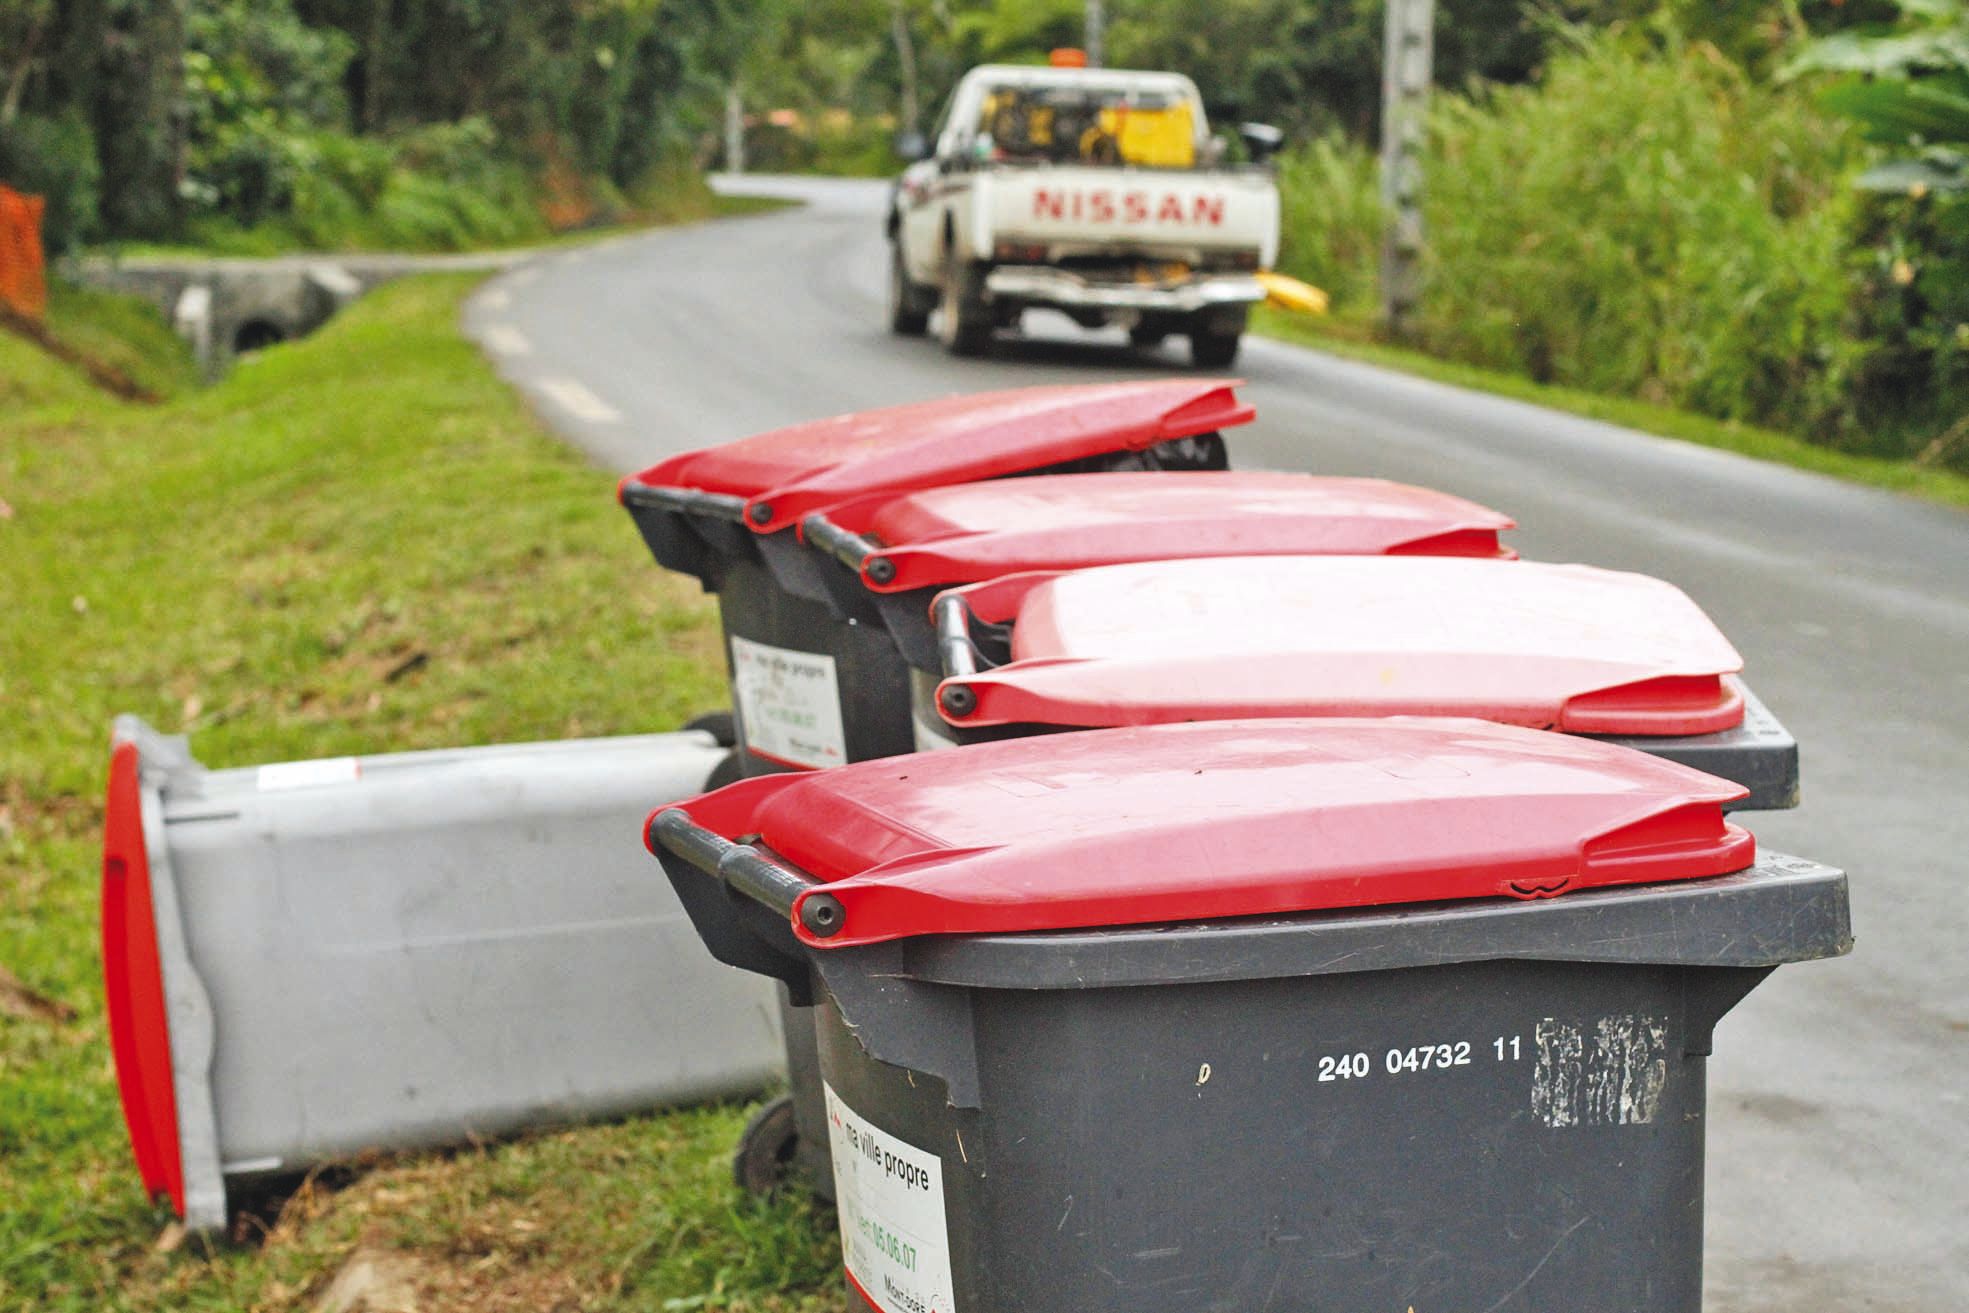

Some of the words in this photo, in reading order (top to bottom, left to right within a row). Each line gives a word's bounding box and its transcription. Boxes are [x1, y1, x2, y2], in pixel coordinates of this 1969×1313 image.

[1033, 189, 1224, 226] NISSAN
[1318, 1052, 1370, 1081] 240
[1385, 1041, 1471, 1074] 04732
[1493, 1035, 1520, 1061] 11
[859, 1131, 881, 1165] ville
[884, 1150, 929, 1191] propre
